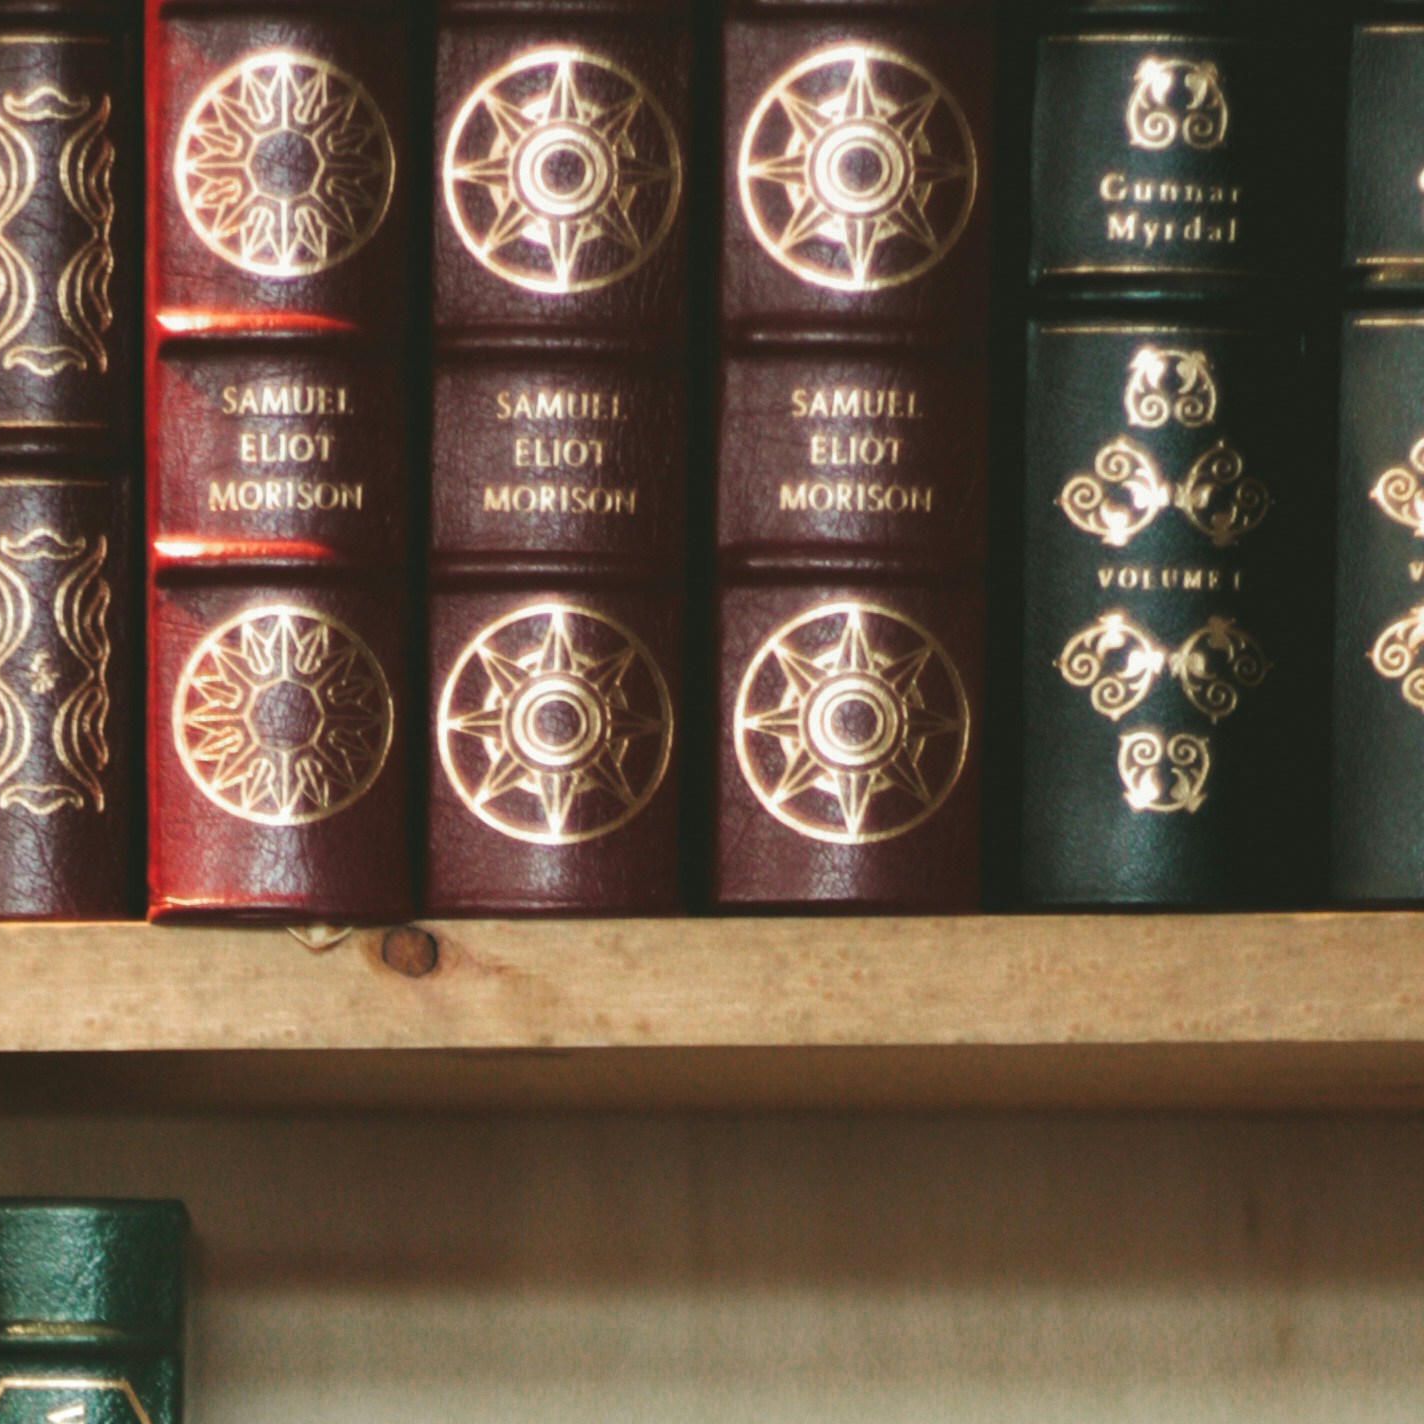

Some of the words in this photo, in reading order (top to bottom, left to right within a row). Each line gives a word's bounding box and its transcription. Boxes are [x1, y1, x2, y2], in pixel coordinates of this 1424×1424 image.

[1099, 174, 1242, 205] Gunnar
[1107, 212, 1238, 245] Myrdal
[221, 385, 353, 416] SAMUEL
[495, 391, 627, 423] SAMUEL
[791, 389, 922, 419] SAMUEL
[241, 434, 334, 463] ELIOT
[514, 440, 605, 468] ELIOT
[810, 437, 901, 465] ELIOT
[208, 482, 363, 512] MORISON
[483, 485, 636, 515] MORISON
[780, 483, 933, 514] MORISON
[1097, 567, 1221, 590] VOLUME
